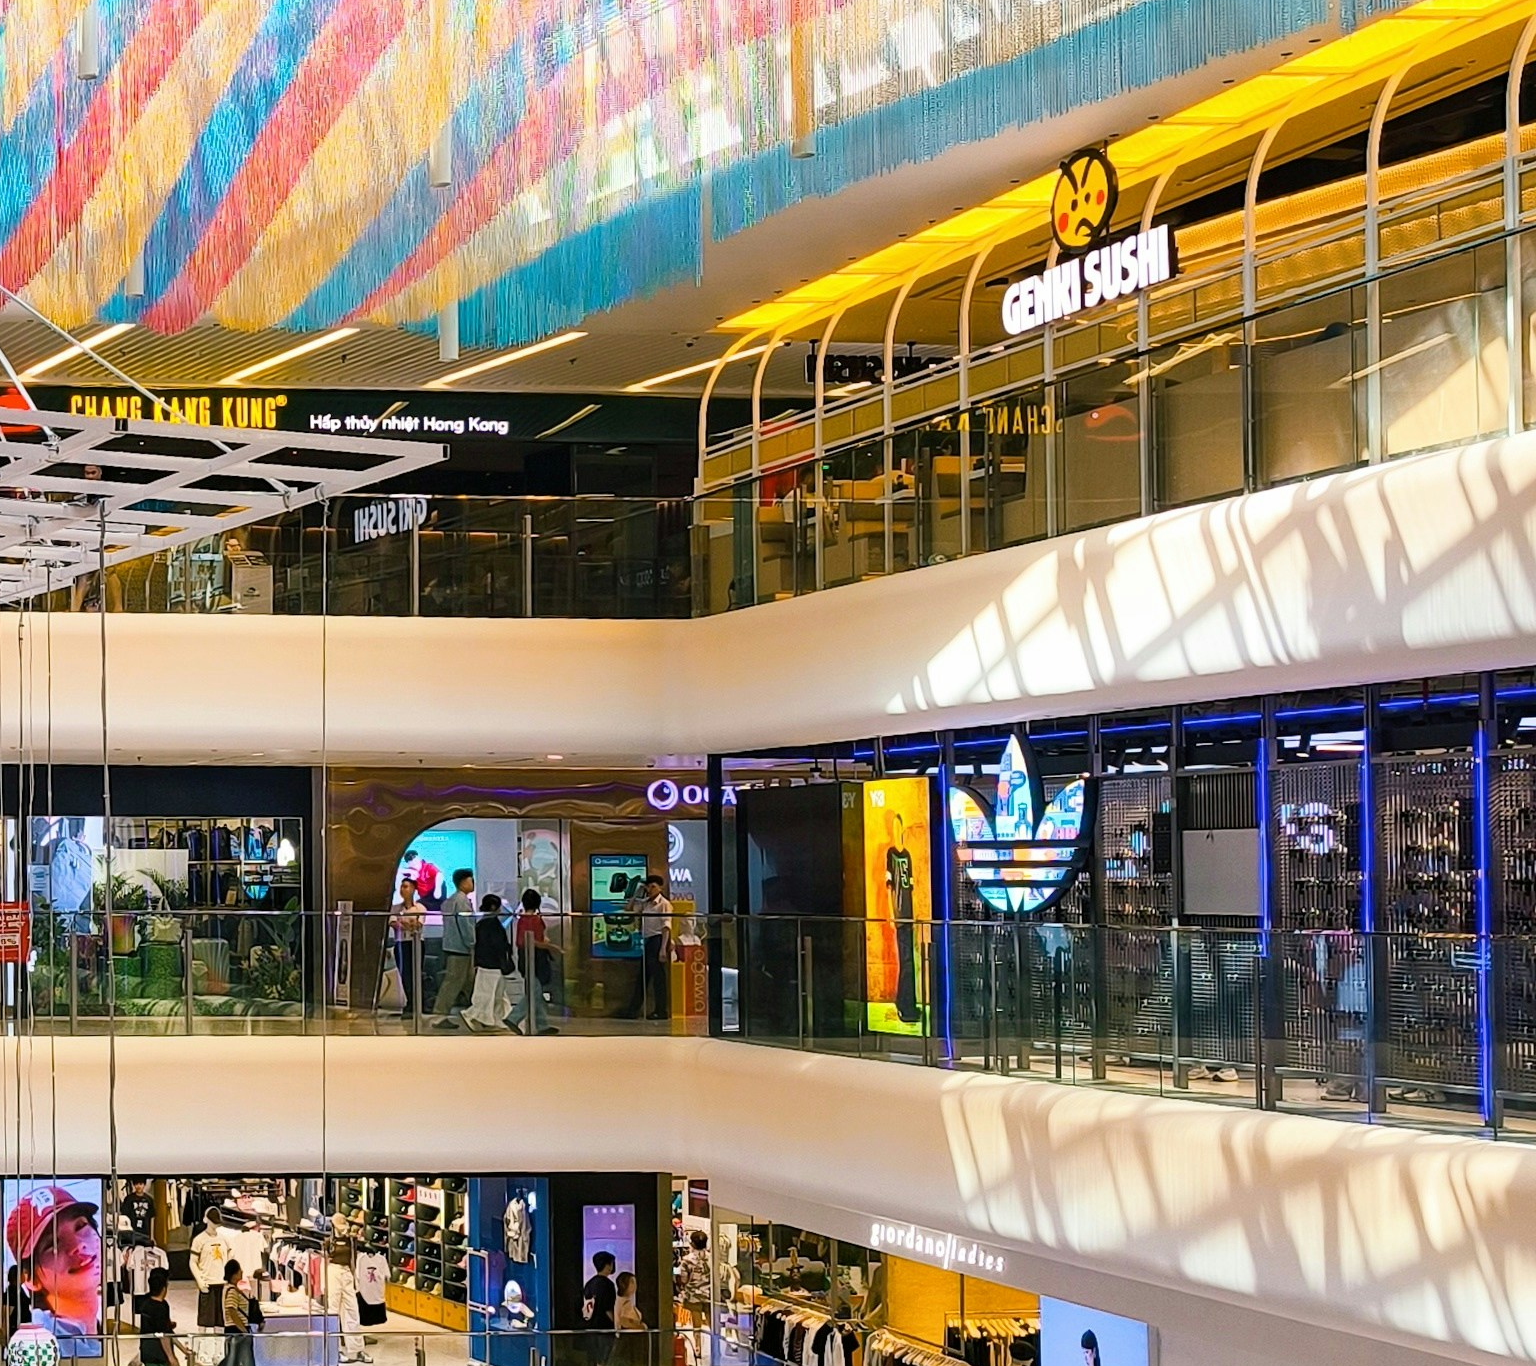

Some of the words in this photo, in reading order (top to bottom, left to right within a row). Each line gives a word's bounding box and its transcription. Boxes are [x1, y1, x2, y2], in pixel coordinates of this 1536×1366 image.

[1002, 258, 1082, 335] GENKI
[1083, 224, 1170, 307] SUSHI
[423, 417, 464, 434] Hong
[468, 417, 510, 435] Kong
